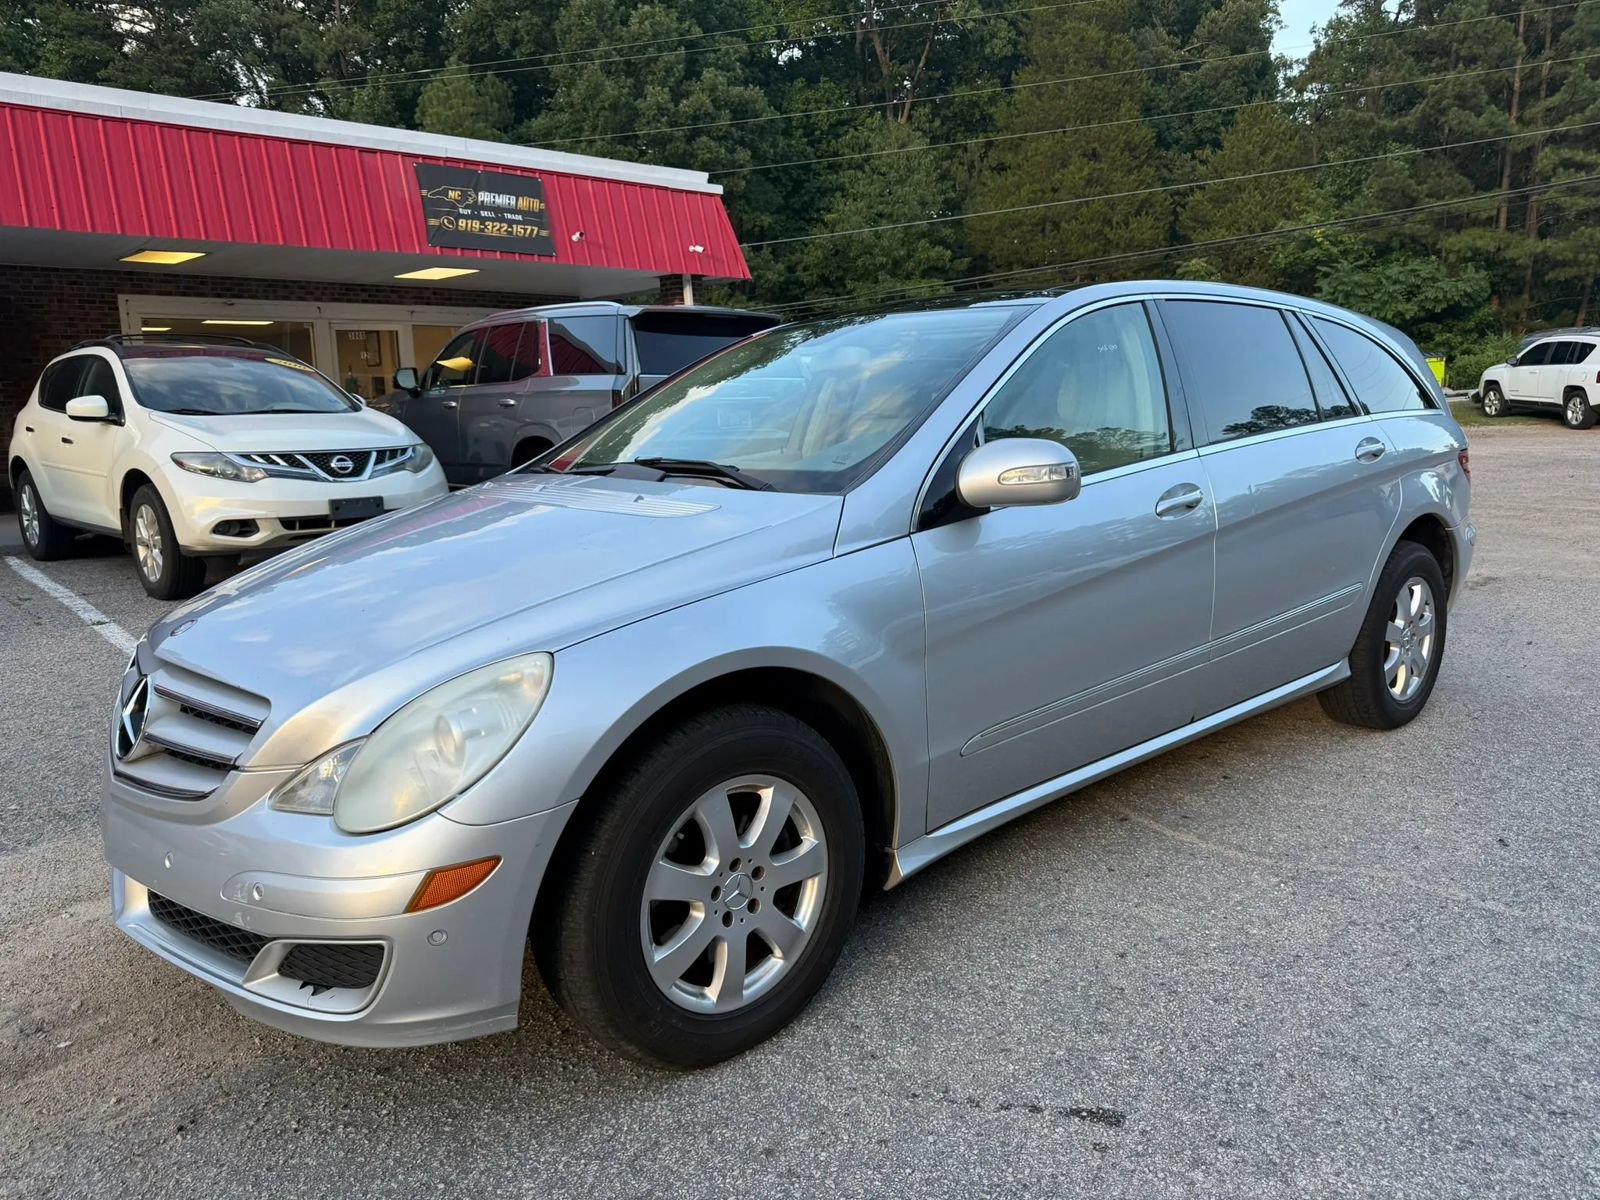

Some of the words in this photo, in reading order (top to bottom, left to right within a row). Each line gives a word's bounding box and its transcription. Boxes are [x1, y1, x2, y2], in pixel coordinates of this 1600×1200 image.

[448, 190, 461, 200] NC
[477, 191, 517, 209] PREMIER
[517, 195, 540, 212] AUTO
[480, 210, 496, 218] SELL
[503, 212, 523, 221] TRADE
[458, 218, 539, 238] 919-322-1577
